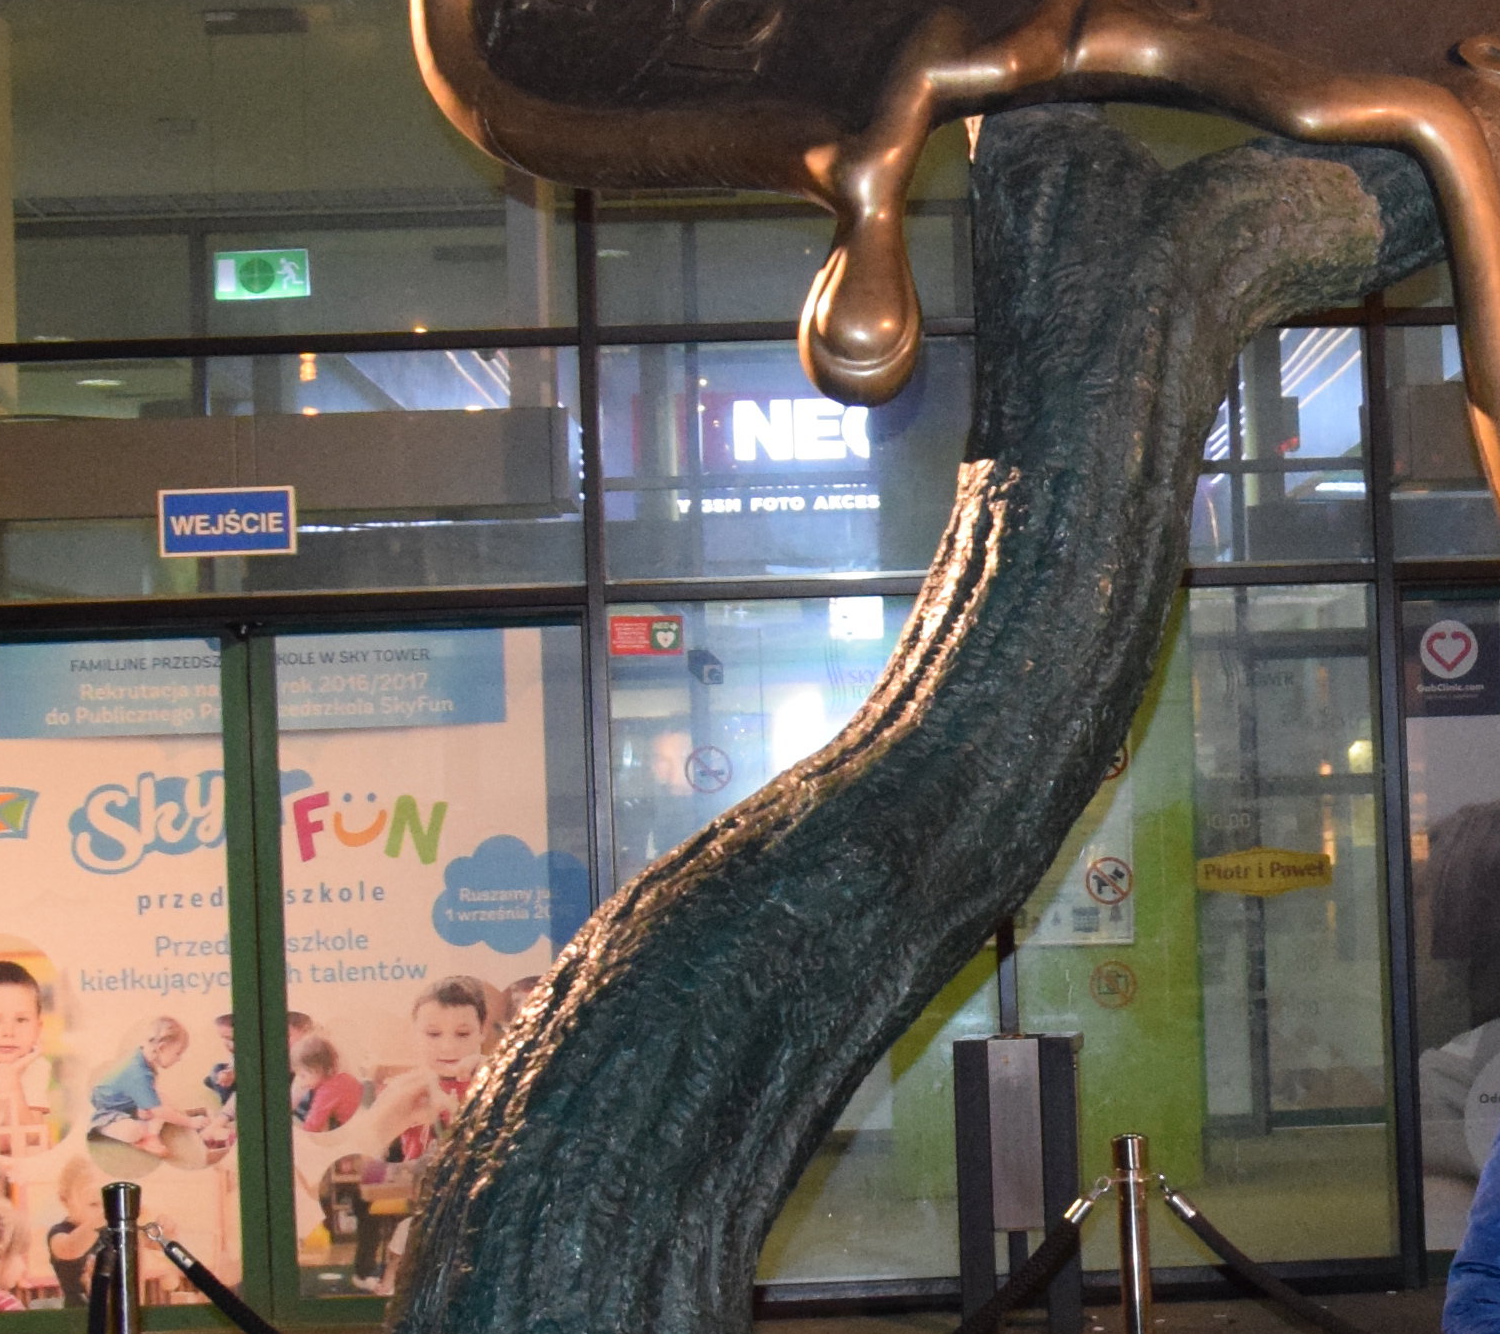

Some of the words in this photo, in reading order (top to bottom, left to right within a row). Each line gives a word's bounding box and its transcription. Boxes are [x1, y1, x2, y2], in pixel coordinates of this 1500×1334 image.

[750, 496, 806, 512] FOTO
[169, 508, 285, 536] WEJŚCIE
[319, 651, 336, 666] W
[339, 649, 369, 665] SKY
[372, 647, 431, 663] TOWER
[78, 681, 190, 704] Rekrutacja
[193, 685, 219, 699] na
[280, 676, 314, 694] rok
[318, 671, 429, 695] 2016/2017
[45, 708, 70, 726] do
[74, 705, 195, 729] Publicznego
[379, 696, 455, 716] SkyFun
[309, 957, 428, 985] talentów
